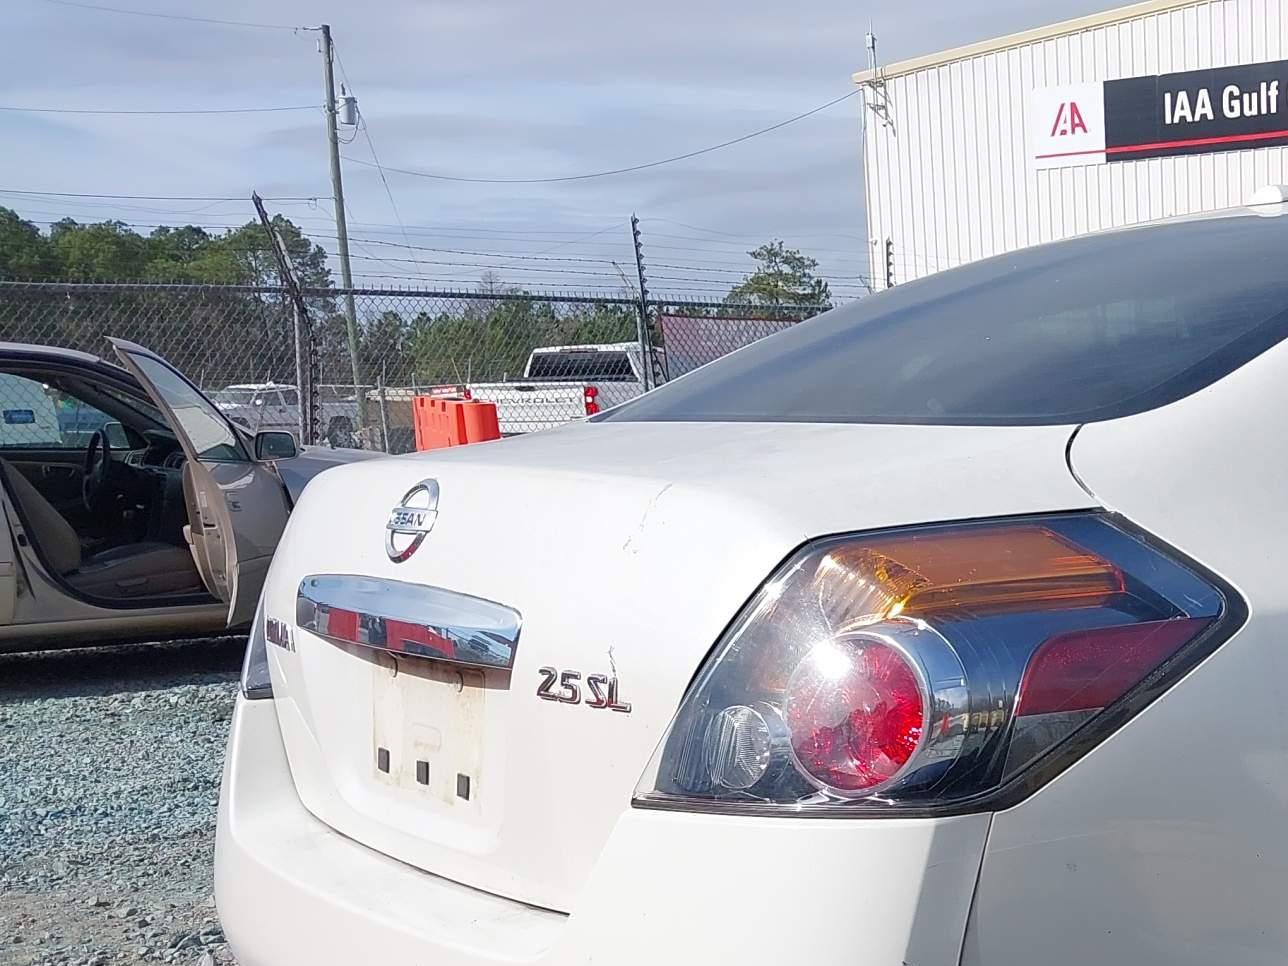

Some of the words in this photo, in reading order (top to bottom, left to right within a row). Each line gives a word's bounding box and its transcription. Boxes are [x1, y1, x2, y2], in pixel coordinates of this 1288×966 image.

[1164, 89, 1214, 124] IAA
[1222, 81, 1279, 118] Gulf
[584, 673, 632, 713] SL
